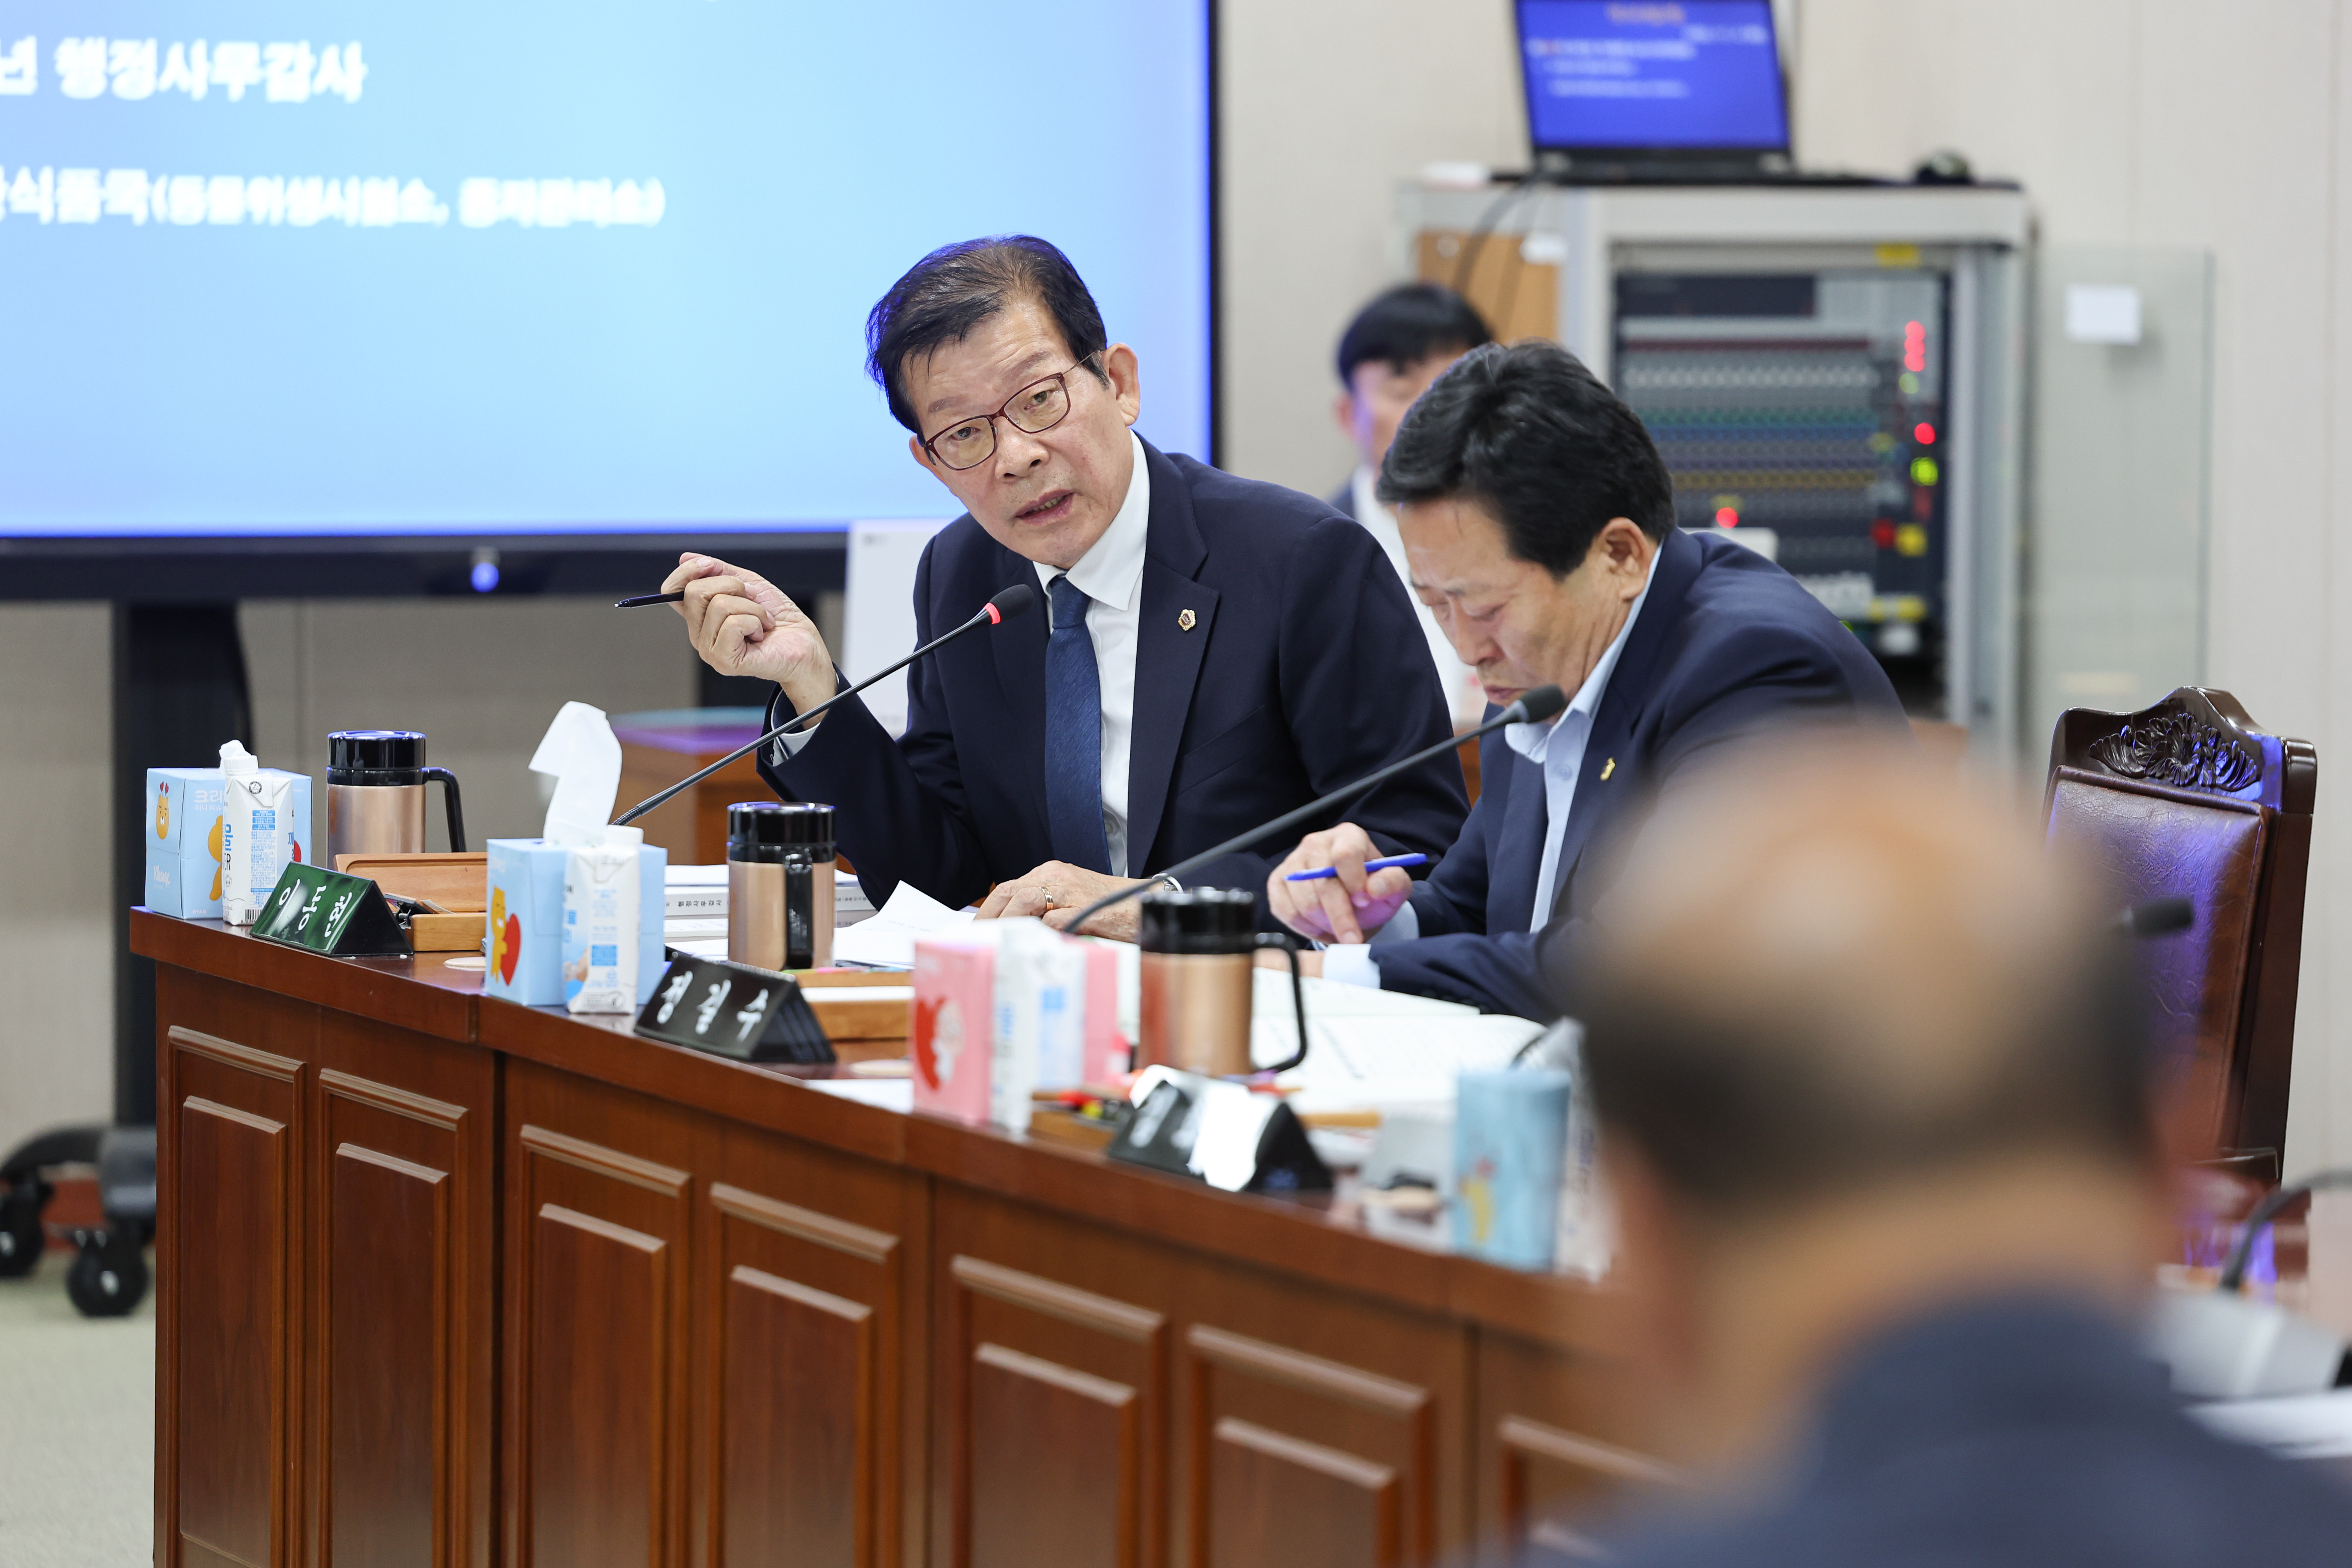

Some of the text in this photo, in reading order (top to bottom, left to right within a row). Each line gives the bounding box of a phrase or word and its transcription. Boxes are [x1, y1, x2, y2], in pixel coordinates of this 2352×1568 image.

[54, 36, 369, 103] 행정사무감사
[0, 166, 450, 228] 식품국(동물위생시험소,
[275, 878, 353, 937] 이동현
[656, 970, 769, 1043] 정길수
